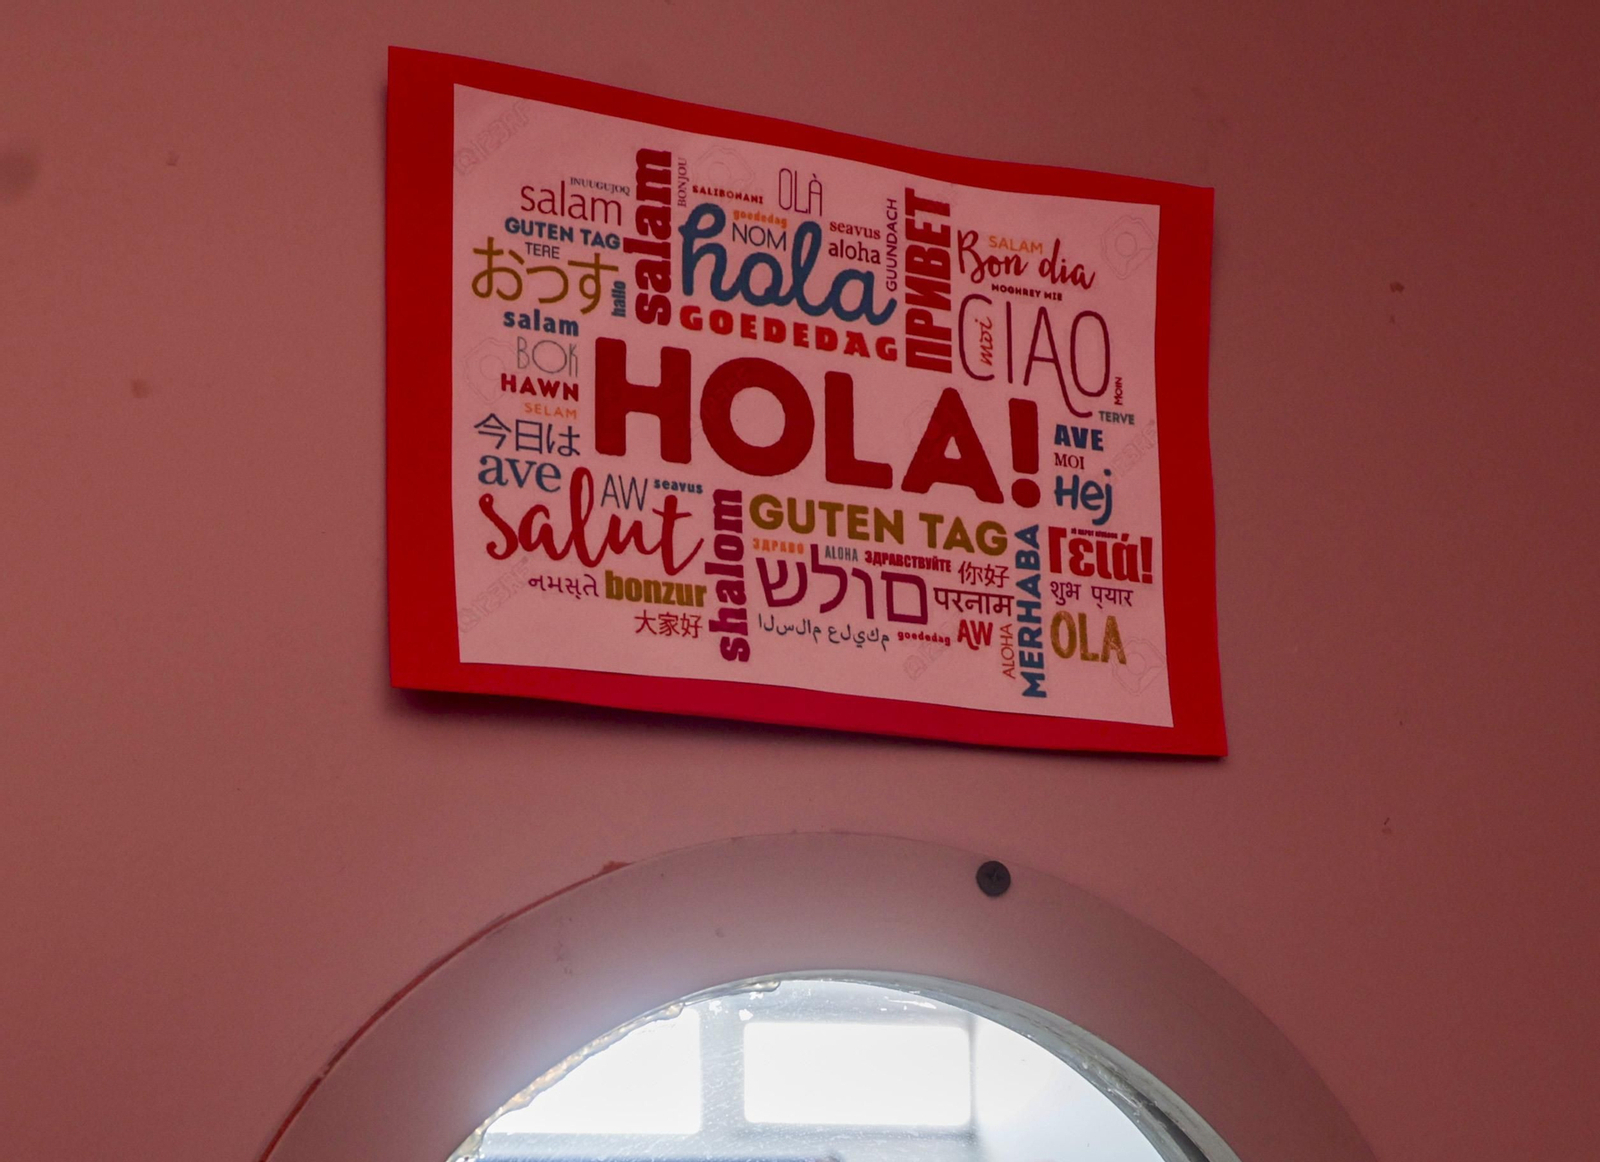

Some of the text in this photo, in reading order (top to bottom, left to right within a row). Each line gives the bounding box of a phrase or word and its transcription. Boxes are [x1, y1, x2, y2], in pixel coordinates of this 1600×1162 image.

[677, 157, 687, 207] BONJOU
[778, 168, 822, 216] OLÀ
[520, 180, 622, 226] salam
[505, 216, 620, 250] GUTEN TAG
[623, 148, 672, 326] salam
[732, 222, 787, 251] NOM
[829, 220, 881, 240] seavus
[886, 198, 898, 292] GUUNDACH
[989, 235, 1043, 255] SALAM
[525, 241, 560, 259] TERE
[678, 202, 897, 326] hola
[828, 239, 881, 265] aloha
[957, 229, 1096, 290] Bon dia
[611, 280, 626, 317] hallo
[905, 187, 952, 374] ПРИВЕТ
[503, 308, 579, 336] salam
[680, 305, 898, 362] GOEDEDAG
[517, 336, 578, 378] BOK
[958, 293, 1110, 418] CIAO
[975, 316, 993, 367] moi
[501, 373, 579, 402] HAWN
[1114, 376, 1123, 406] MOIN
[524, 402, 577, 420] SELAM
[595, 336, 1041, 509] HOLA!
[1098, 410, 1135, 425] TERVE
[474, 413, 580, 457] 今日は
[1054, 424, 1104, 452] AVE
[478, 454, 561, 493] ave
[1054, 453, 1085, 470] MOI
[600, 473, 648, 511] AW
[653, 478, 703, 495] seavus
[1054, 468, 1112, 526] Hej
[478, 466, 704, 576] salut
[750, 494, 1008, 556] GUTEN TAG
[825, 545, 858, 562] ALOHA
[865, 550, 951, 573] ЗДРАВСТВУЙТЕ
[605, 570, 707, 608] bonzur
[704, 488, 750, 662] shalom
[958, 560, 1010, 588] 你好
[1050, 581, 1081, 605] शुभ
[933, 587, 1014, 617] परनाम
[1015, 524, 1047, 698] MERHABA
[634, 609, 703, 639] 大家好
[897, 630, 951, 647] goededag
[957, 619, 993, 650] AW
[1051, 610, 1126, 665] OLA
[1000, 623, 1016, 679] ALOHA
